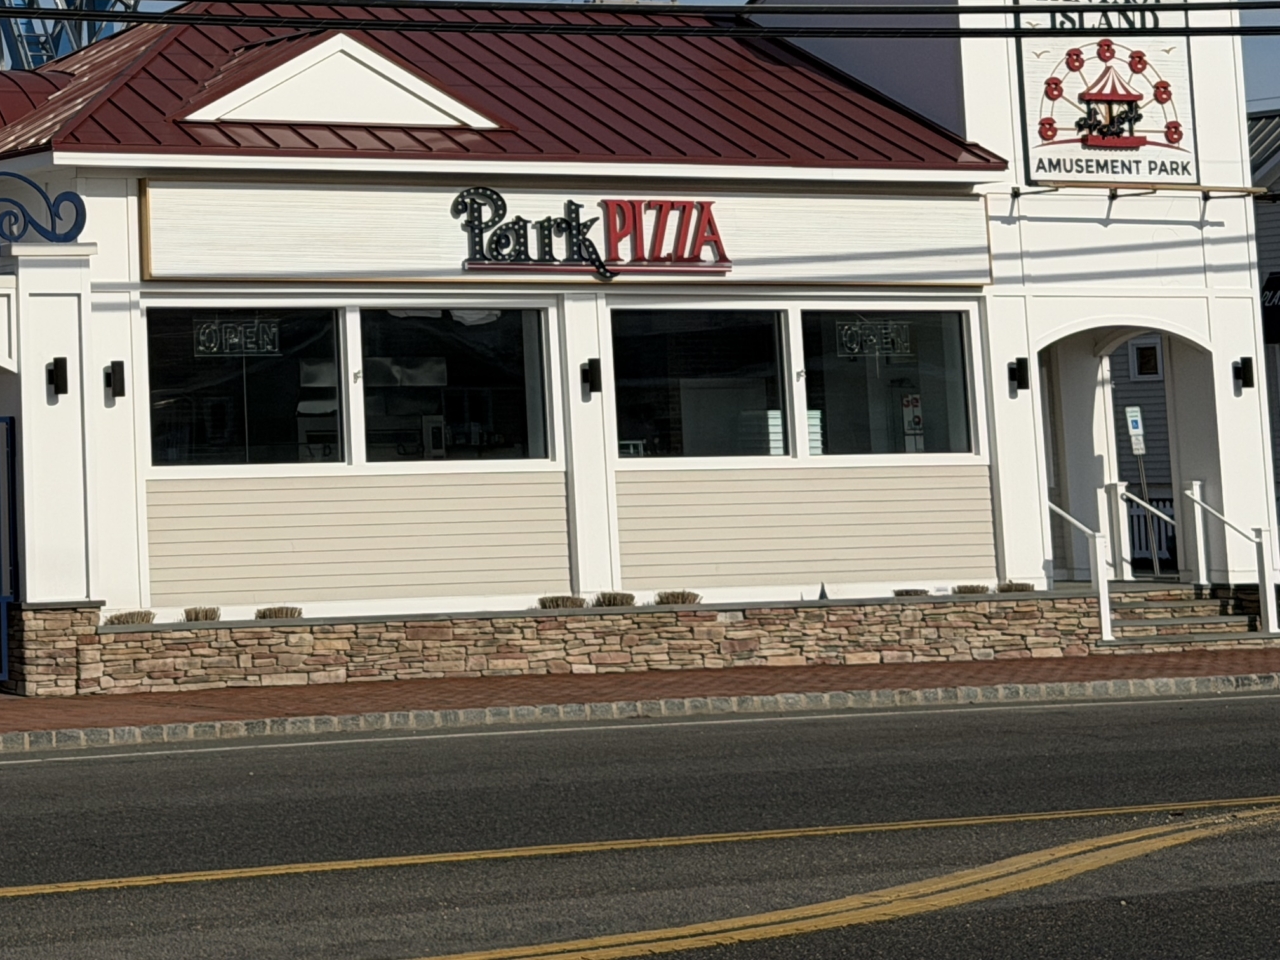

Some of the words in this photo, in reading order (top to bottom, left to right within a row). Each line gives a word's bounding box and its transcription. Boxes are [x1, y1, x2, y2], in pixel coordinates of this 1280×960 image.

[1050, 10, 1160, 29] ISLAND
[1034, 157, 1142, 175] AMUSEMENT
[1147, 160, 1192, 176] PARK
[450, 186, 620, 279] Park
[600, 199, 732, 263] PIZZA
[198, 323, 280, 352] OPEN
[841, 325, 911, 353] OPEN
